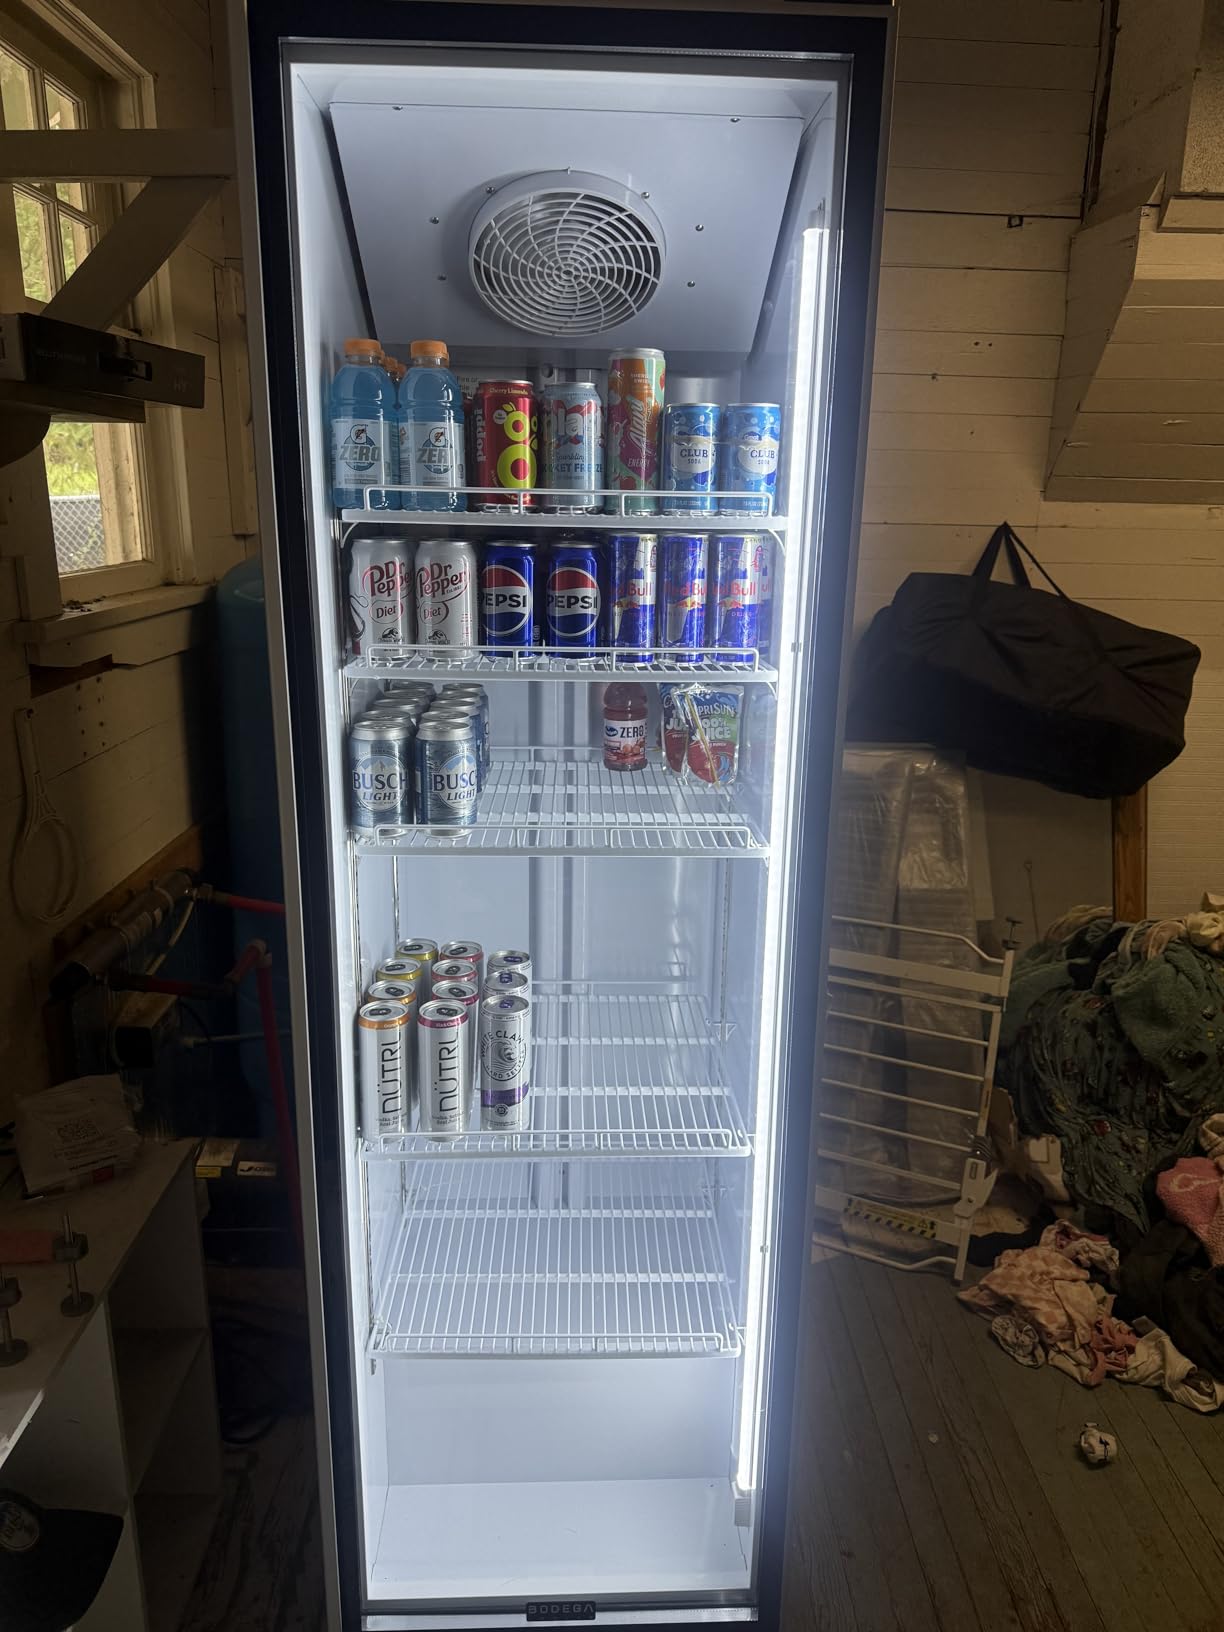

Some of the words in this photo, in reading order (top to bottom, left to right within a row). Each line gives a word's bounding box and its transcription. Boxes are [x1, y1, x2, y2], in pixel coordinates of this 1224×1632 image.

[476, 409, 486, 462] poppi
[339, 446, 382, 462] ZERO
[416, 448, 459, 464] ZER
[680, 449, 708, 458] CLUB
[750, 449, 775, 458] CLUB
[574, 463, 603, 473] FREZE
[385, 560, 405, 580] Dr
[431, 562, 452, 580] Dr
[363, 566, 412, 597] Peppe
[416, 567, 467, 597] Pepper
[627, 581, 652, 597] Bull
[692, 581, 707, 596] Bu
[730, 581, 756, 596] Bull
[483, 593, 527, 608] EPSI
[547, 595, 598, 609] PEPSI
[376, 605, 397, 618] Diet
[424, 607, 442, 620] Diet
[700, 717, 727, 729] 00%
[620, 725, 644, 738] ZERO
[353, 772, 408, 790] BUSCH
[433, 770, 476, 791] BUSC
[363, 791, 398, 801] LIGHT
[447, 788, 475, 801] LIGHT
[480, 1031, 495, 1058] WHITE
[496, 1030, 525, 1044] CLAW
[528, 1603, 594, 1614] BODEGA
